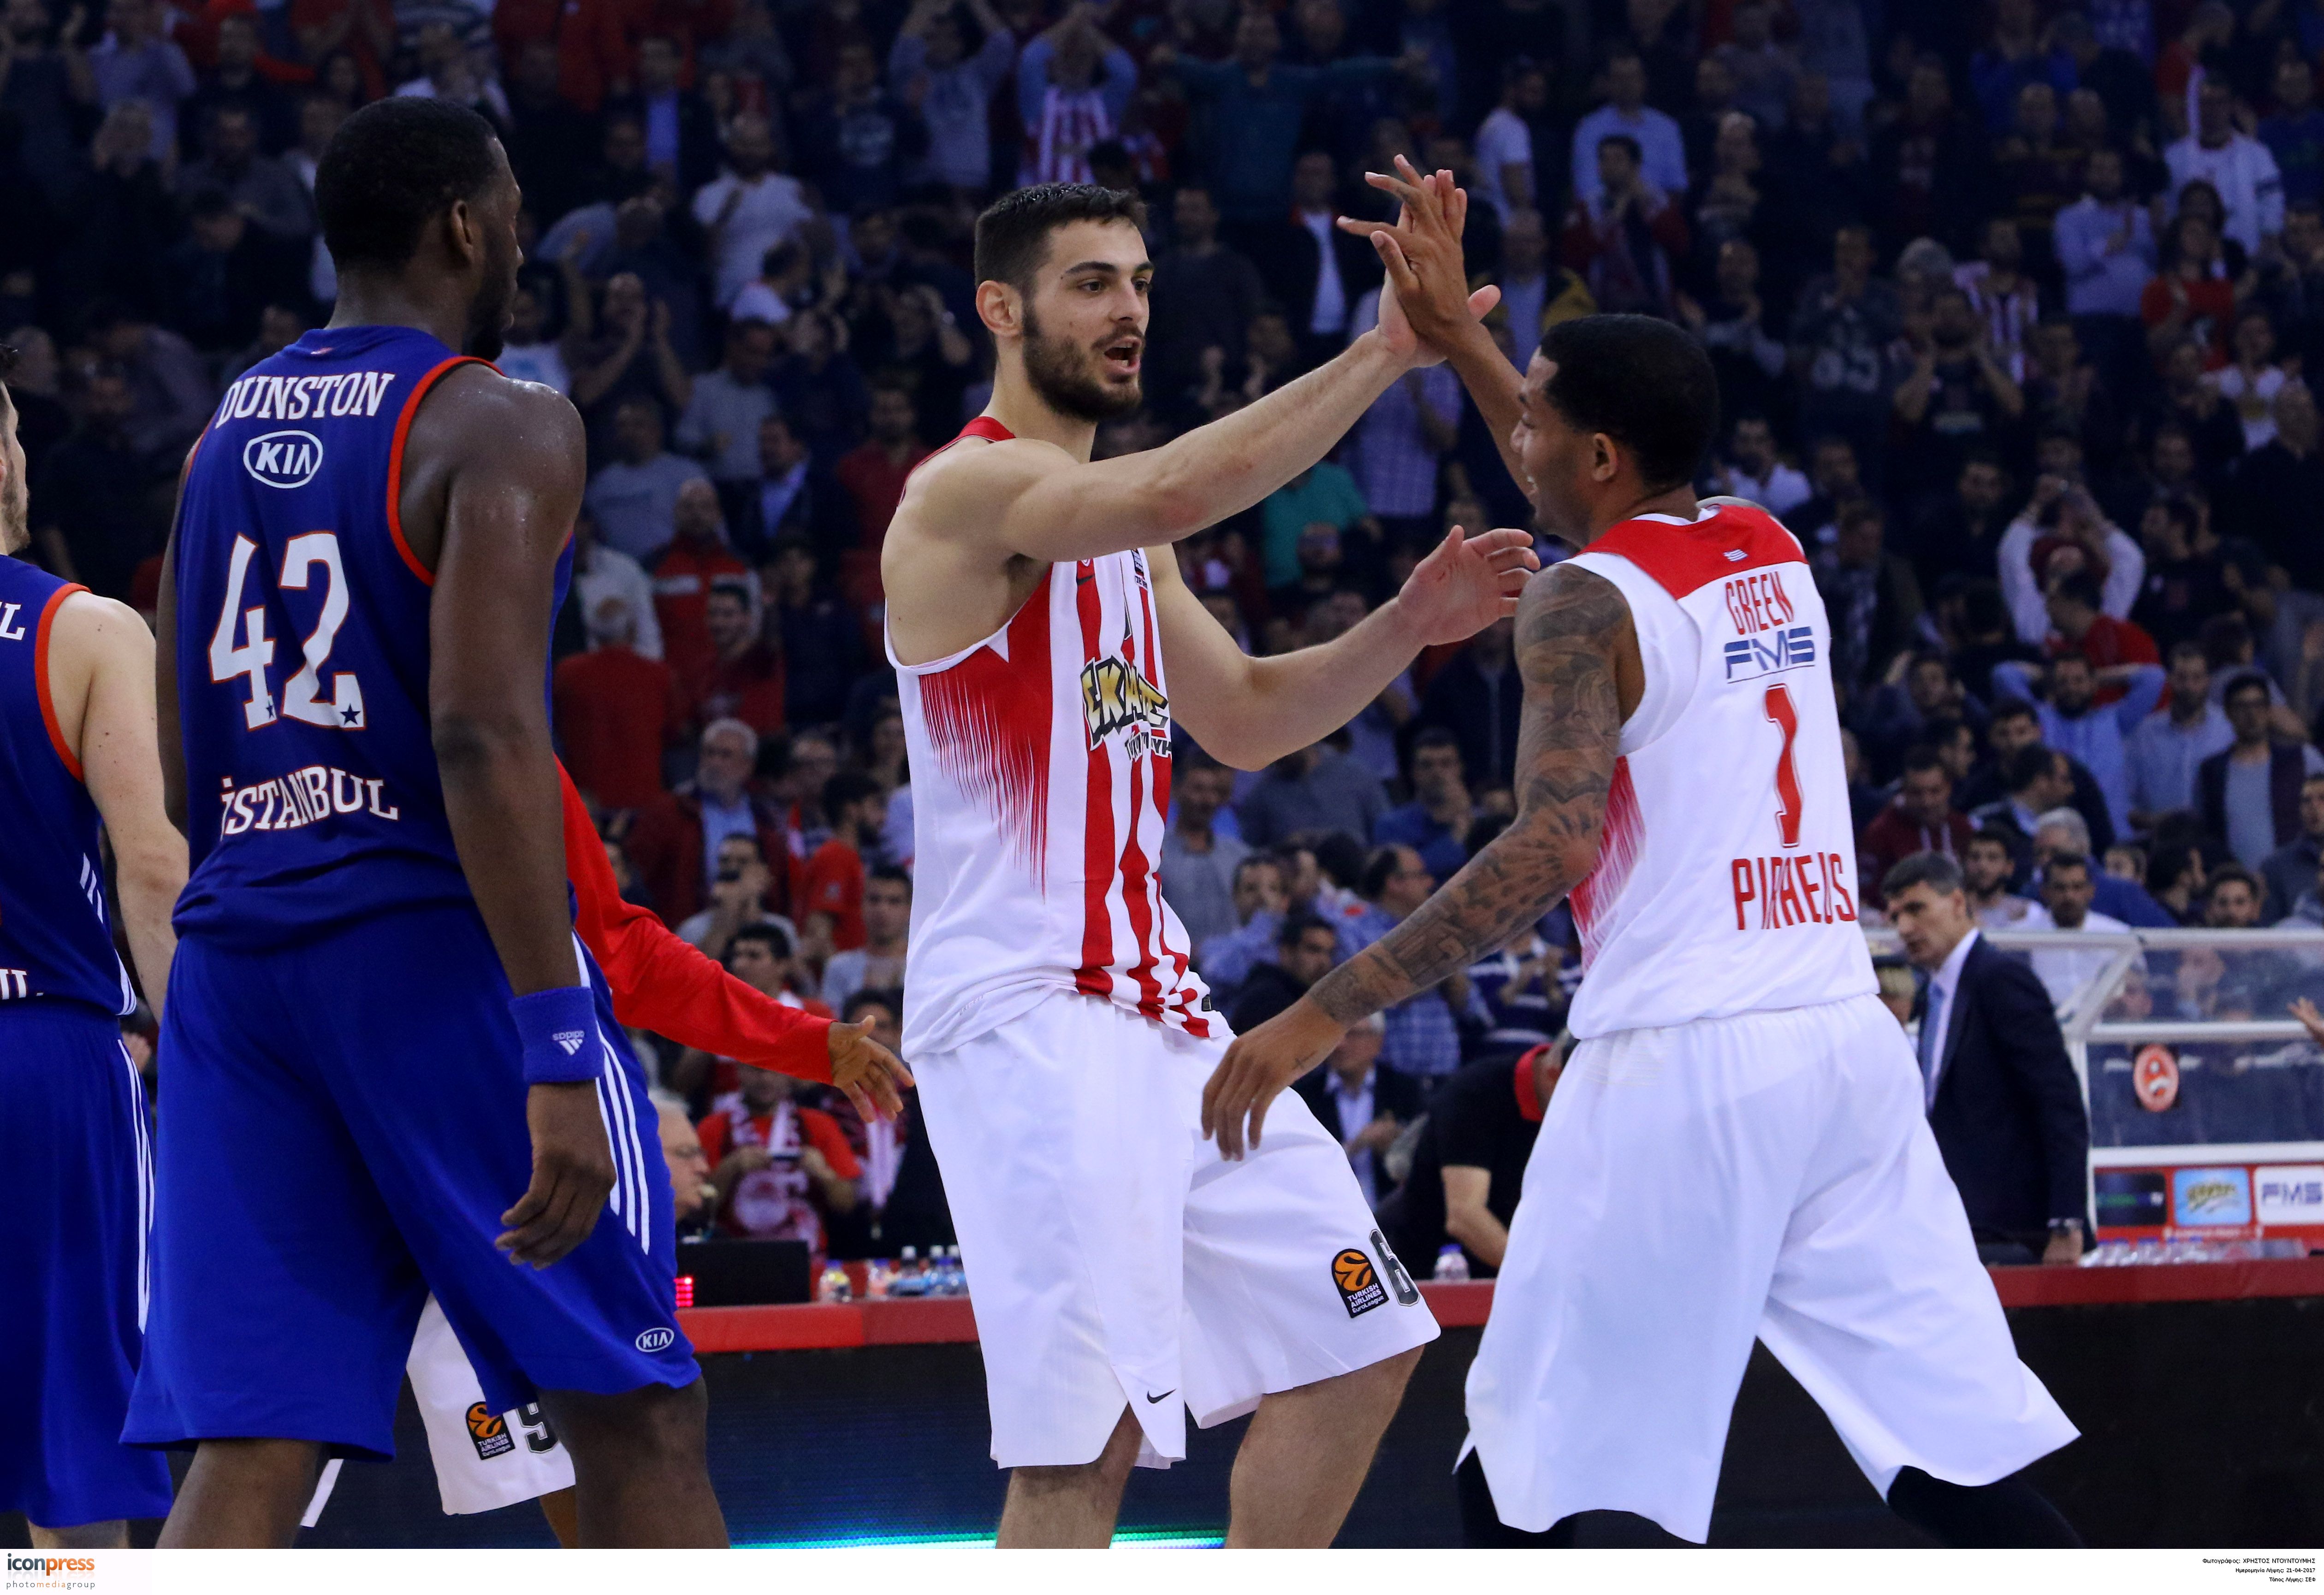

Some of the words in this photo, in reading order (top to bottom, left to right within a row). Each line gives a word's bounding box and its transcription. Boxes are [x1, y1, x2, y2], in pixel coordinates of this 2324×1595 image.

[215, 372, 395, 429] DUNSTON
[255, 441, 311, 475] KIA
[1725, 571, 1795, 635] GREEN
[209, 531, 365, 732] 42
[1724, 626, 1815, 679] FMS
[1762, 683, 1804, 848] 1
[1347, 1283, 1379, 1301] TURKISH
[1351, 1289, 1381, 1308] AIRLINES
[643, 1332, 669, 1348] KIA
